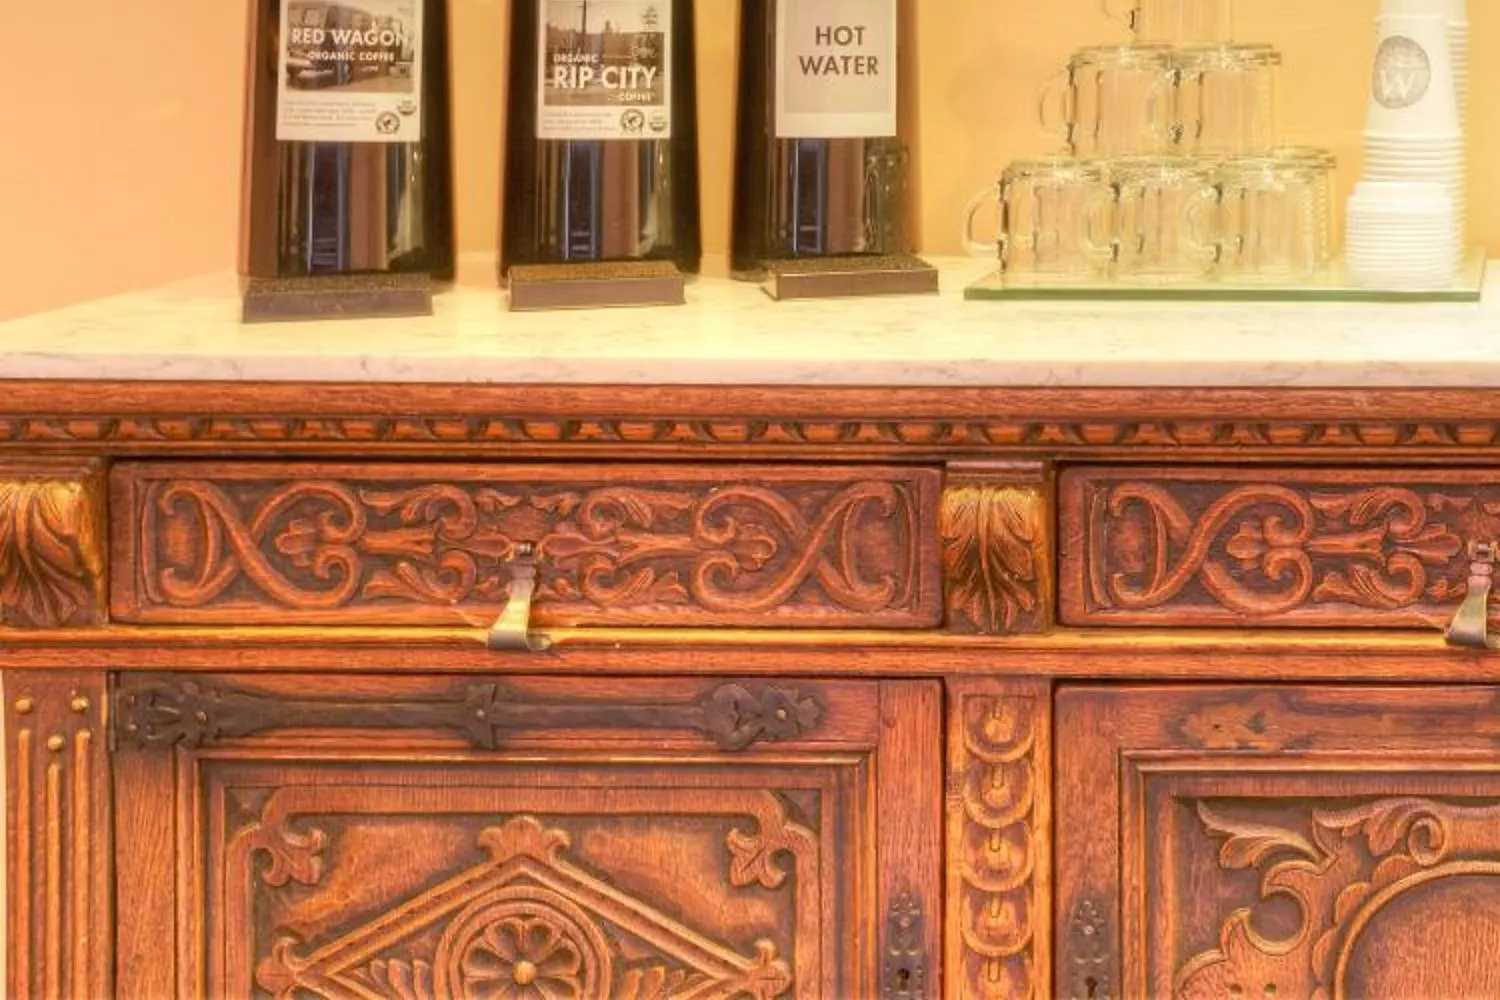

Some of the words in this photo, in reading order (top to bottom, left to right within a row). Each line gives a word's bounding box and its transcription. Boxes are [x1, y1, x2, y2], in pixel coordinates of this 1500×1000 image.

[292, 28, 325, 44] RED
[331, 29, 408, 47] WAGON
[815, 25, 865, 46] HOT
[308, 51, 356, 60] ORGANIC
[359, 51, 395, 61] COFFEE
[799, 56, 879, 76] WATER
[555, 66, 593, 89] RIP
[601, 66, 657, 89] CITY
